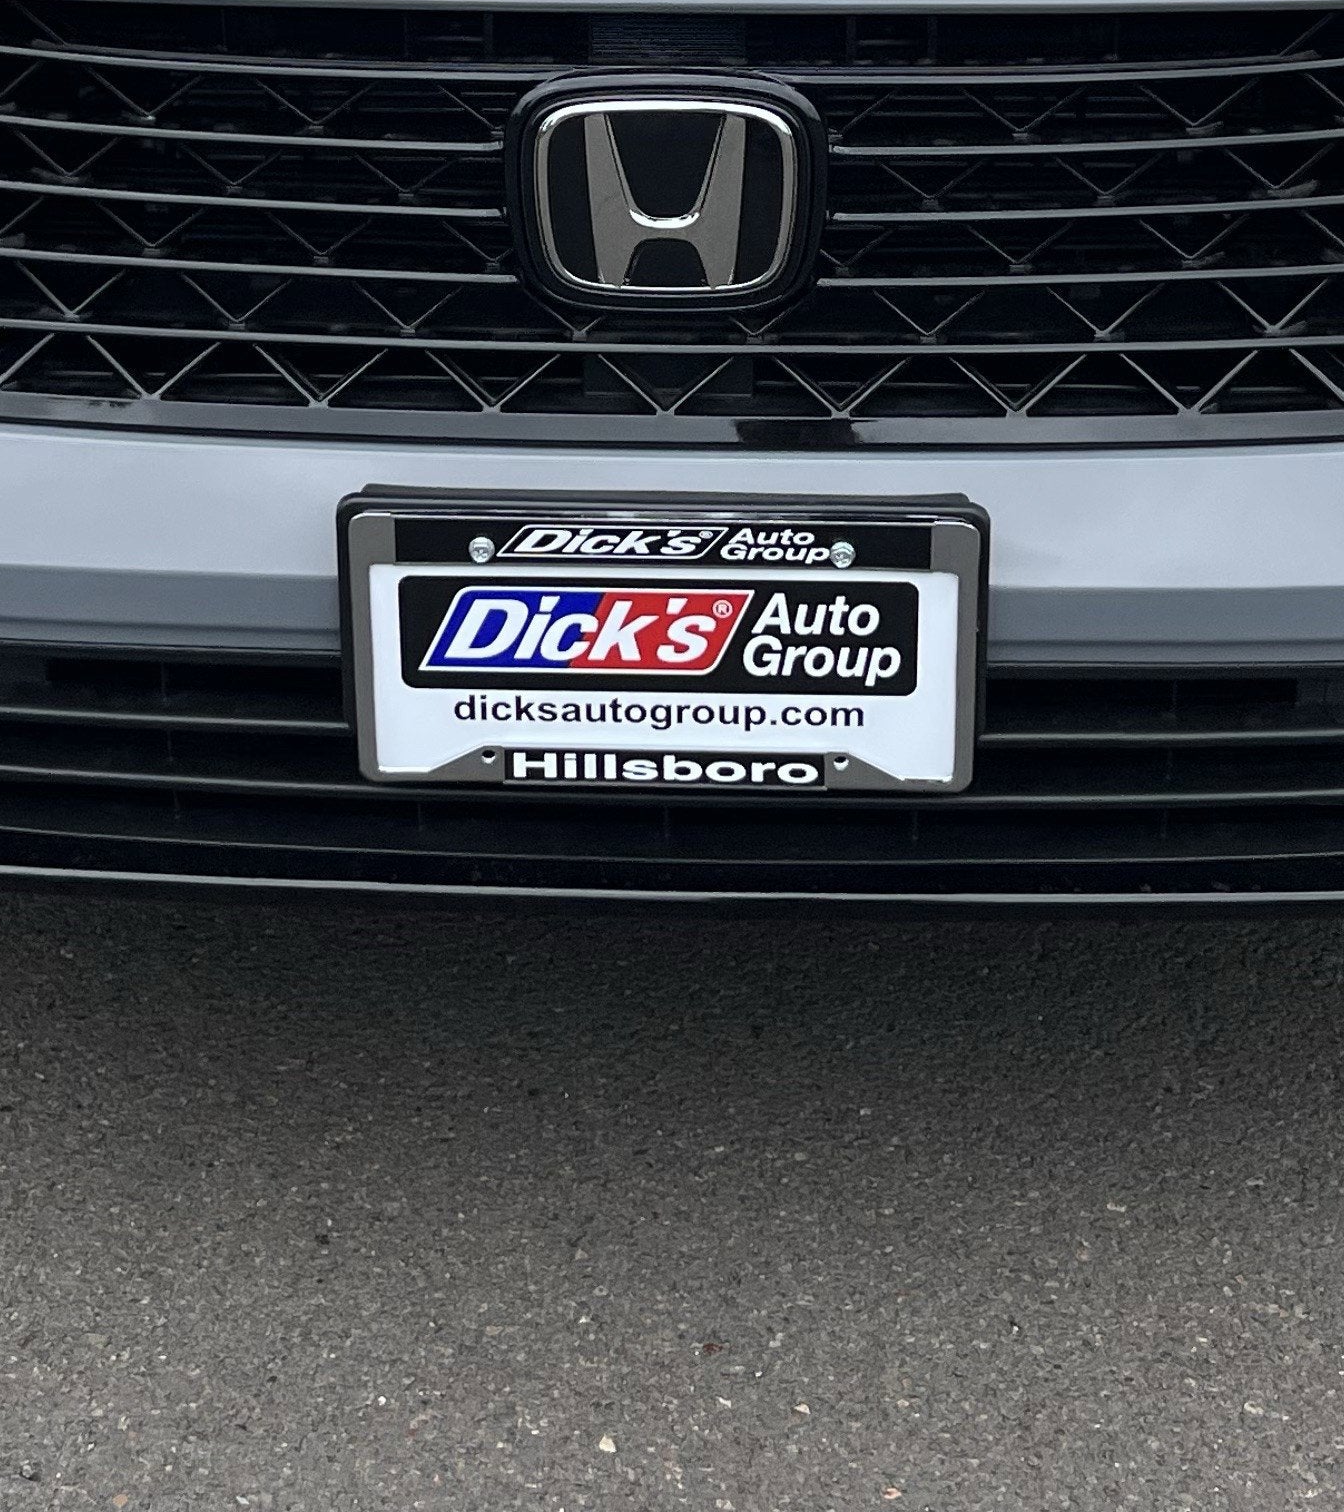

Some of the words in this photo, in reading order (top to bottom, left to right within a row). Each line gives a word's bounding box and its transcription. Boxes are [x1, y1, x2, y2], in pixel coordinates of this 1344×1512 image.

[720, 542, 831, 564] Group
[727, 527, 816, 545] Auto
[751, 592, 880, 636] Auto
[742, 634, 902, 687] Group
[453, 694, 865, 732] dicksautogroup.com
[512, 751, 819, 784] Hillsboro
